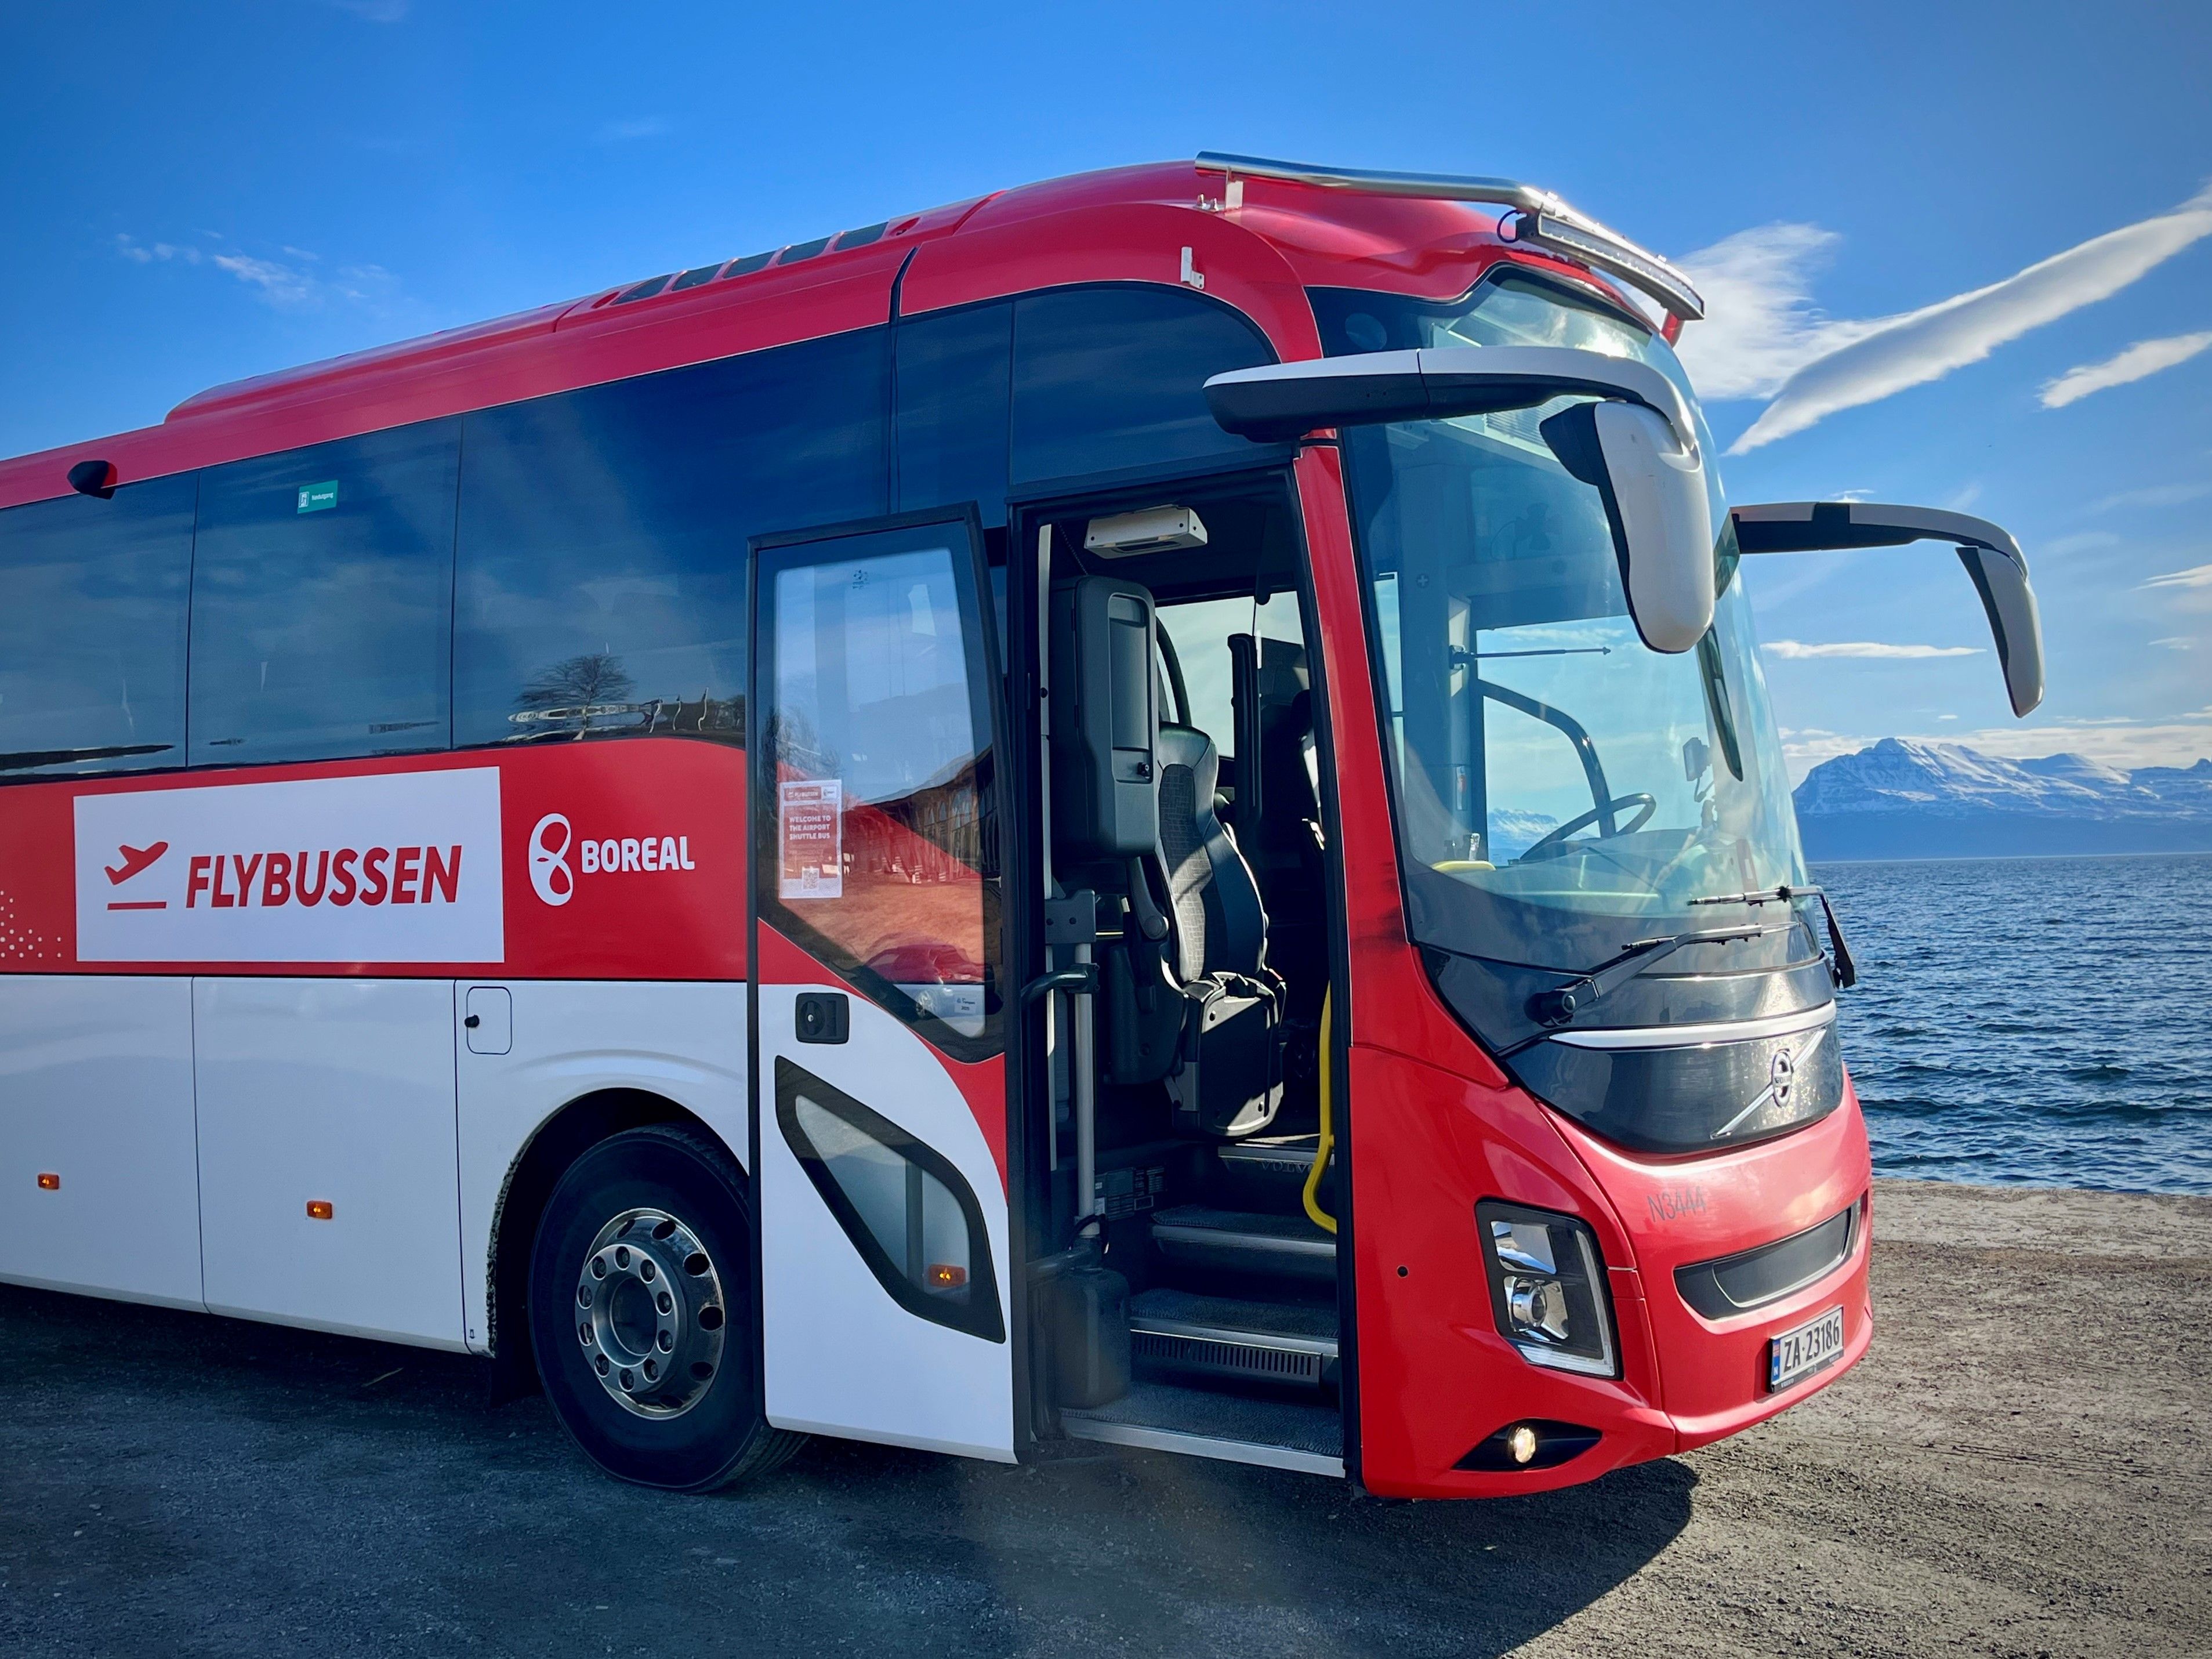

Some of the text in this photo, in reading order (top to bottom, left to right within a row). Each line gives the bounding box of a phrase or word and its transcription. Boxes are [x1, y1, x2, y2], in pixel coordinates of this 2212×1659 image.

[581, 836, 695, 873] BOREAL
[186, 845, 462, 908] FLYBUSSEN
[1648, 1186, 1707, 1222] N3444
